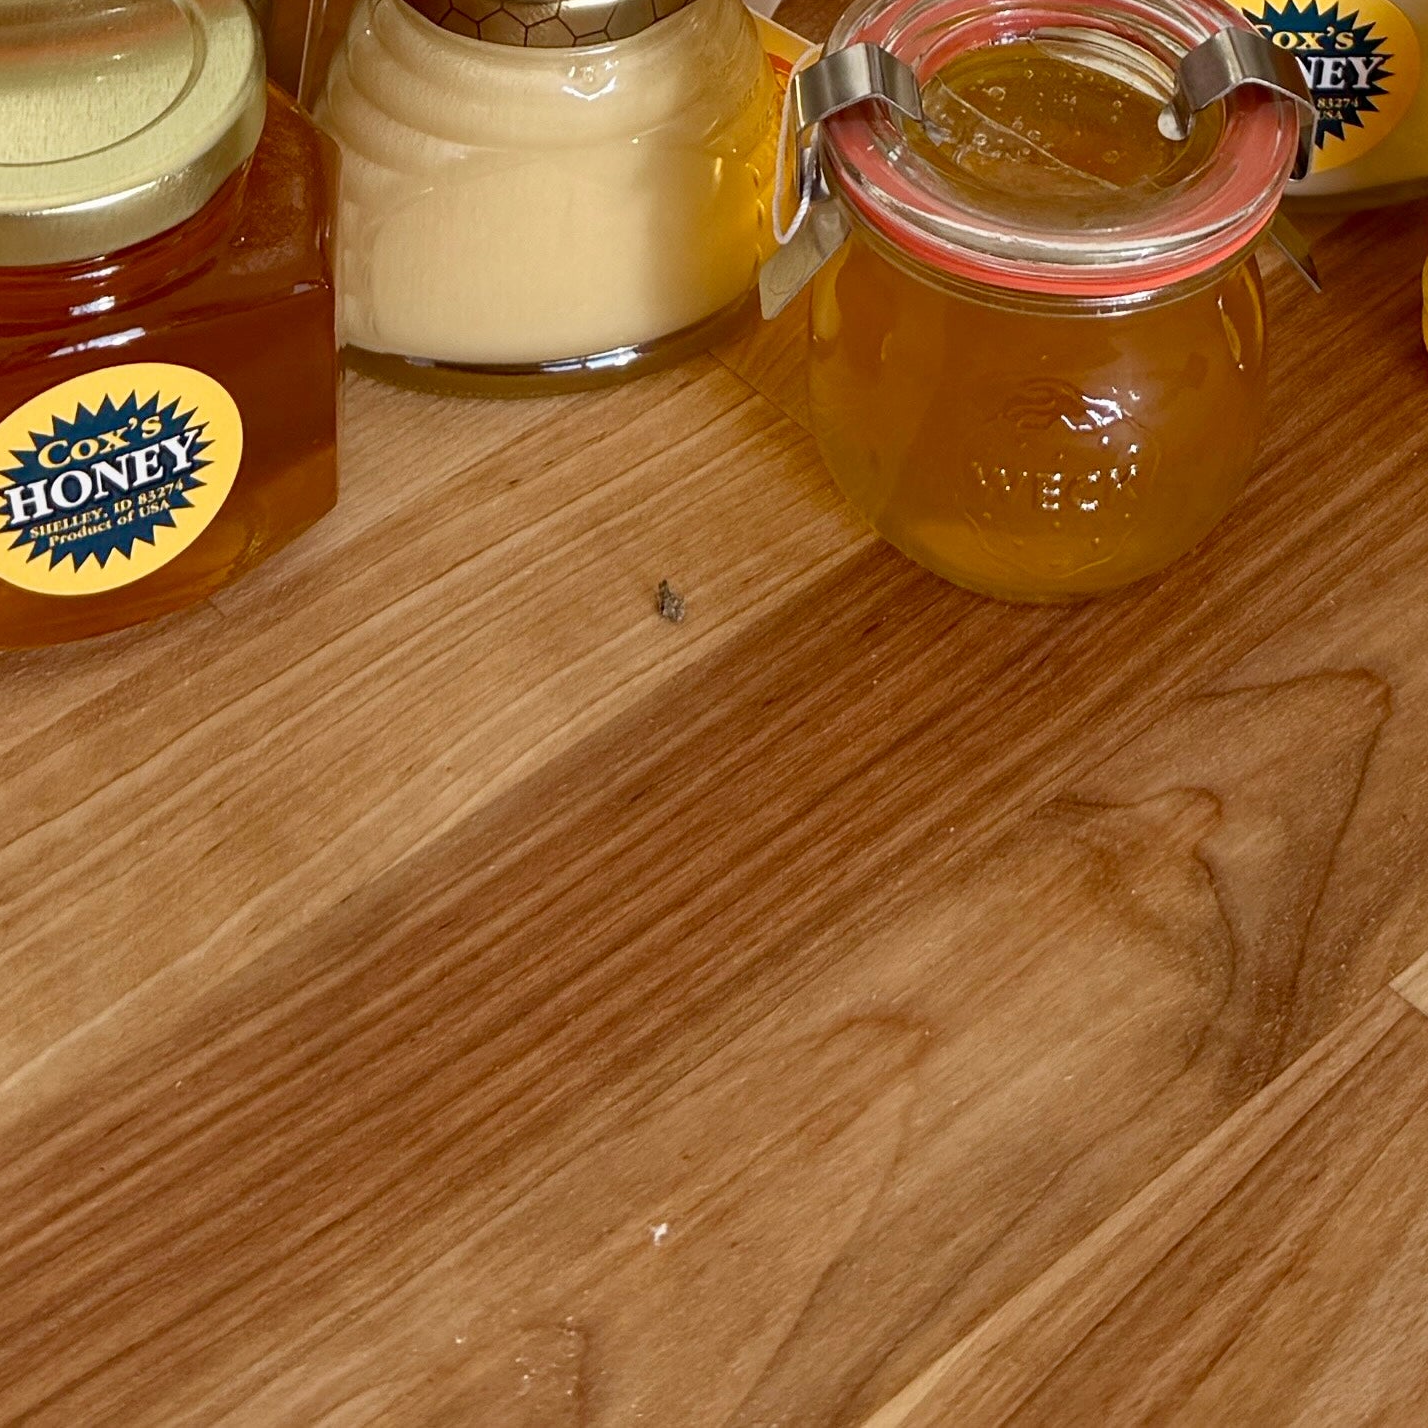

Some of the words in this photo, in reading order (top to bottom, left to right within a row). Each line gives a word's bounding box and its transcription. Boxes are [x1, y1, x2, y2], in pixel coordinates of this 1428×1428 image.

[1294, 55, 1384, 90] NEY
[3, 427, 201, 526] HONEY
[29, 506, 109, 539] SHELLEY,
[113, 498, 133, 514] ID
[137, 477, 184, 505] 83274
[48, 518, 112, 548] Product
[117, 510, 135, 526] of
[139, 499, 171, 518] USA
